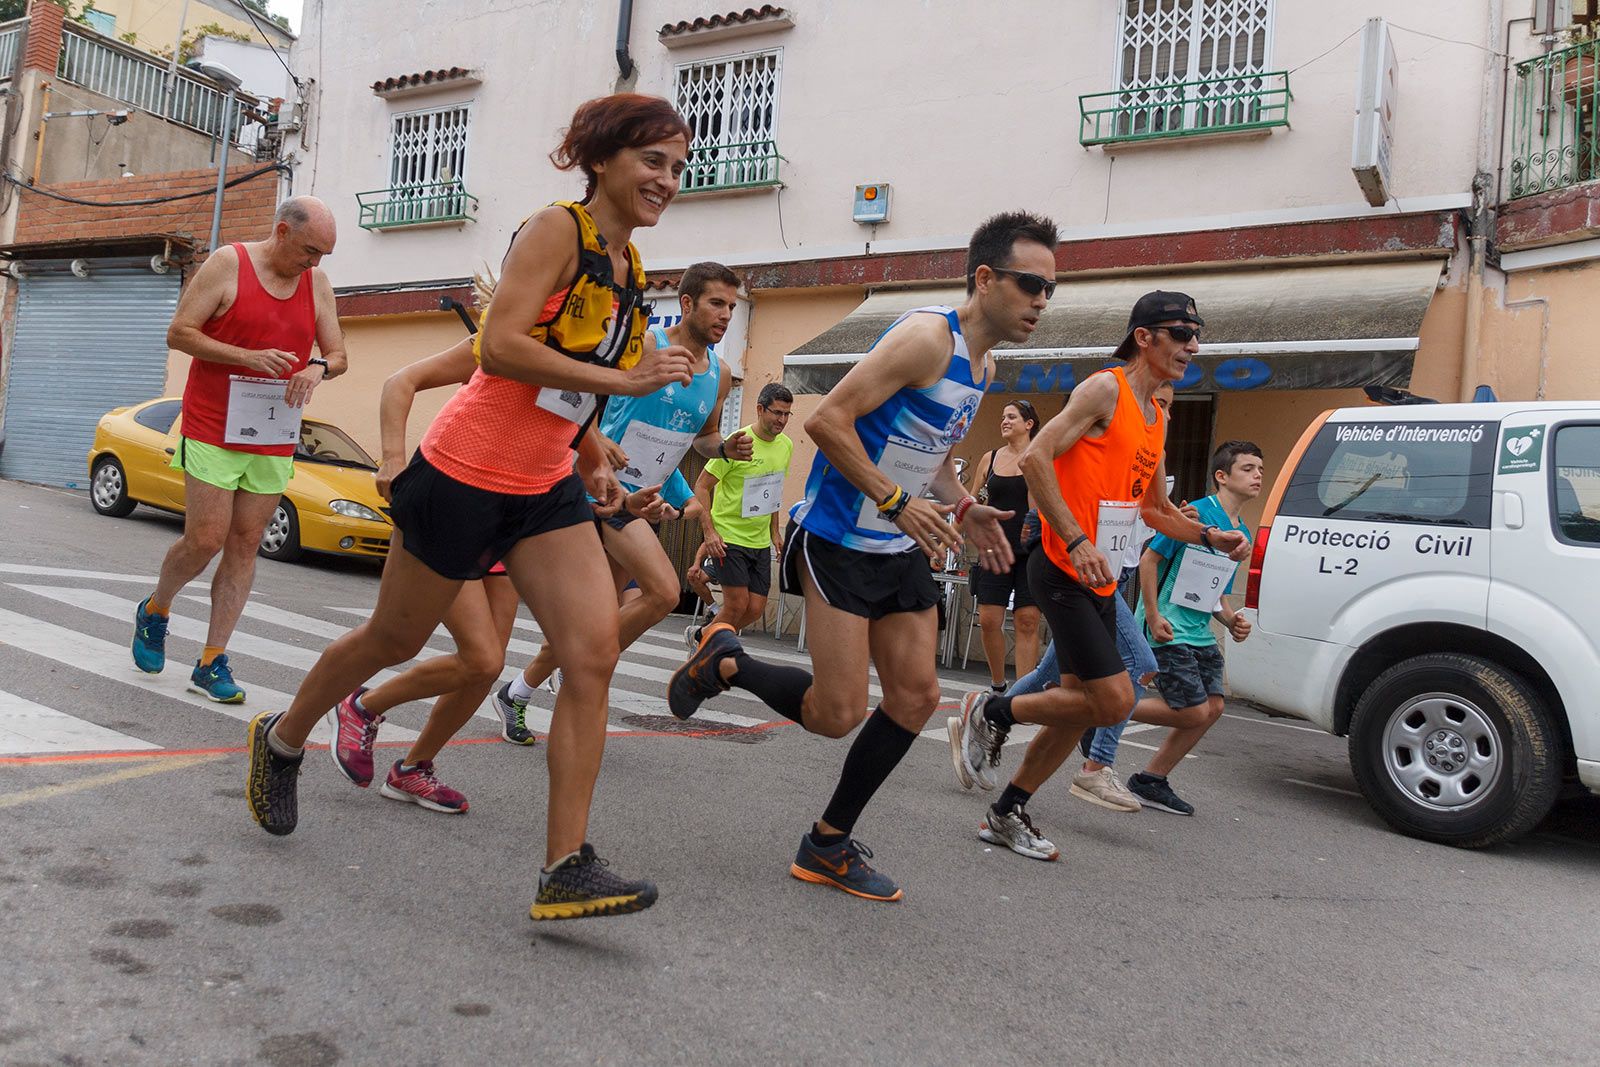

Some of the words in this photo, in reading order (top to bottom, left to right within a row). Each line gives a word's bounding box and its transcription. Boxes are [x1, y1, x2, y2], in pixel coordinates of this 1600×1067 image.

[268, 406, 276, 420] 1
[1335, 425, 1383, 442] Vehicle
[1385, 424, 1484, 443] d'Intervenció
[655, 452, 665, 465] 4
[763, 489, 769, 499] 6
[1110, 534, 1127, 552] 10
[1284, 524, 1391, 550] Protecció
[1415, 534, 1472, 557] Civil
[1318, 556, 1359, 576] L-2
[1210, 576, 1220, 590] 9
